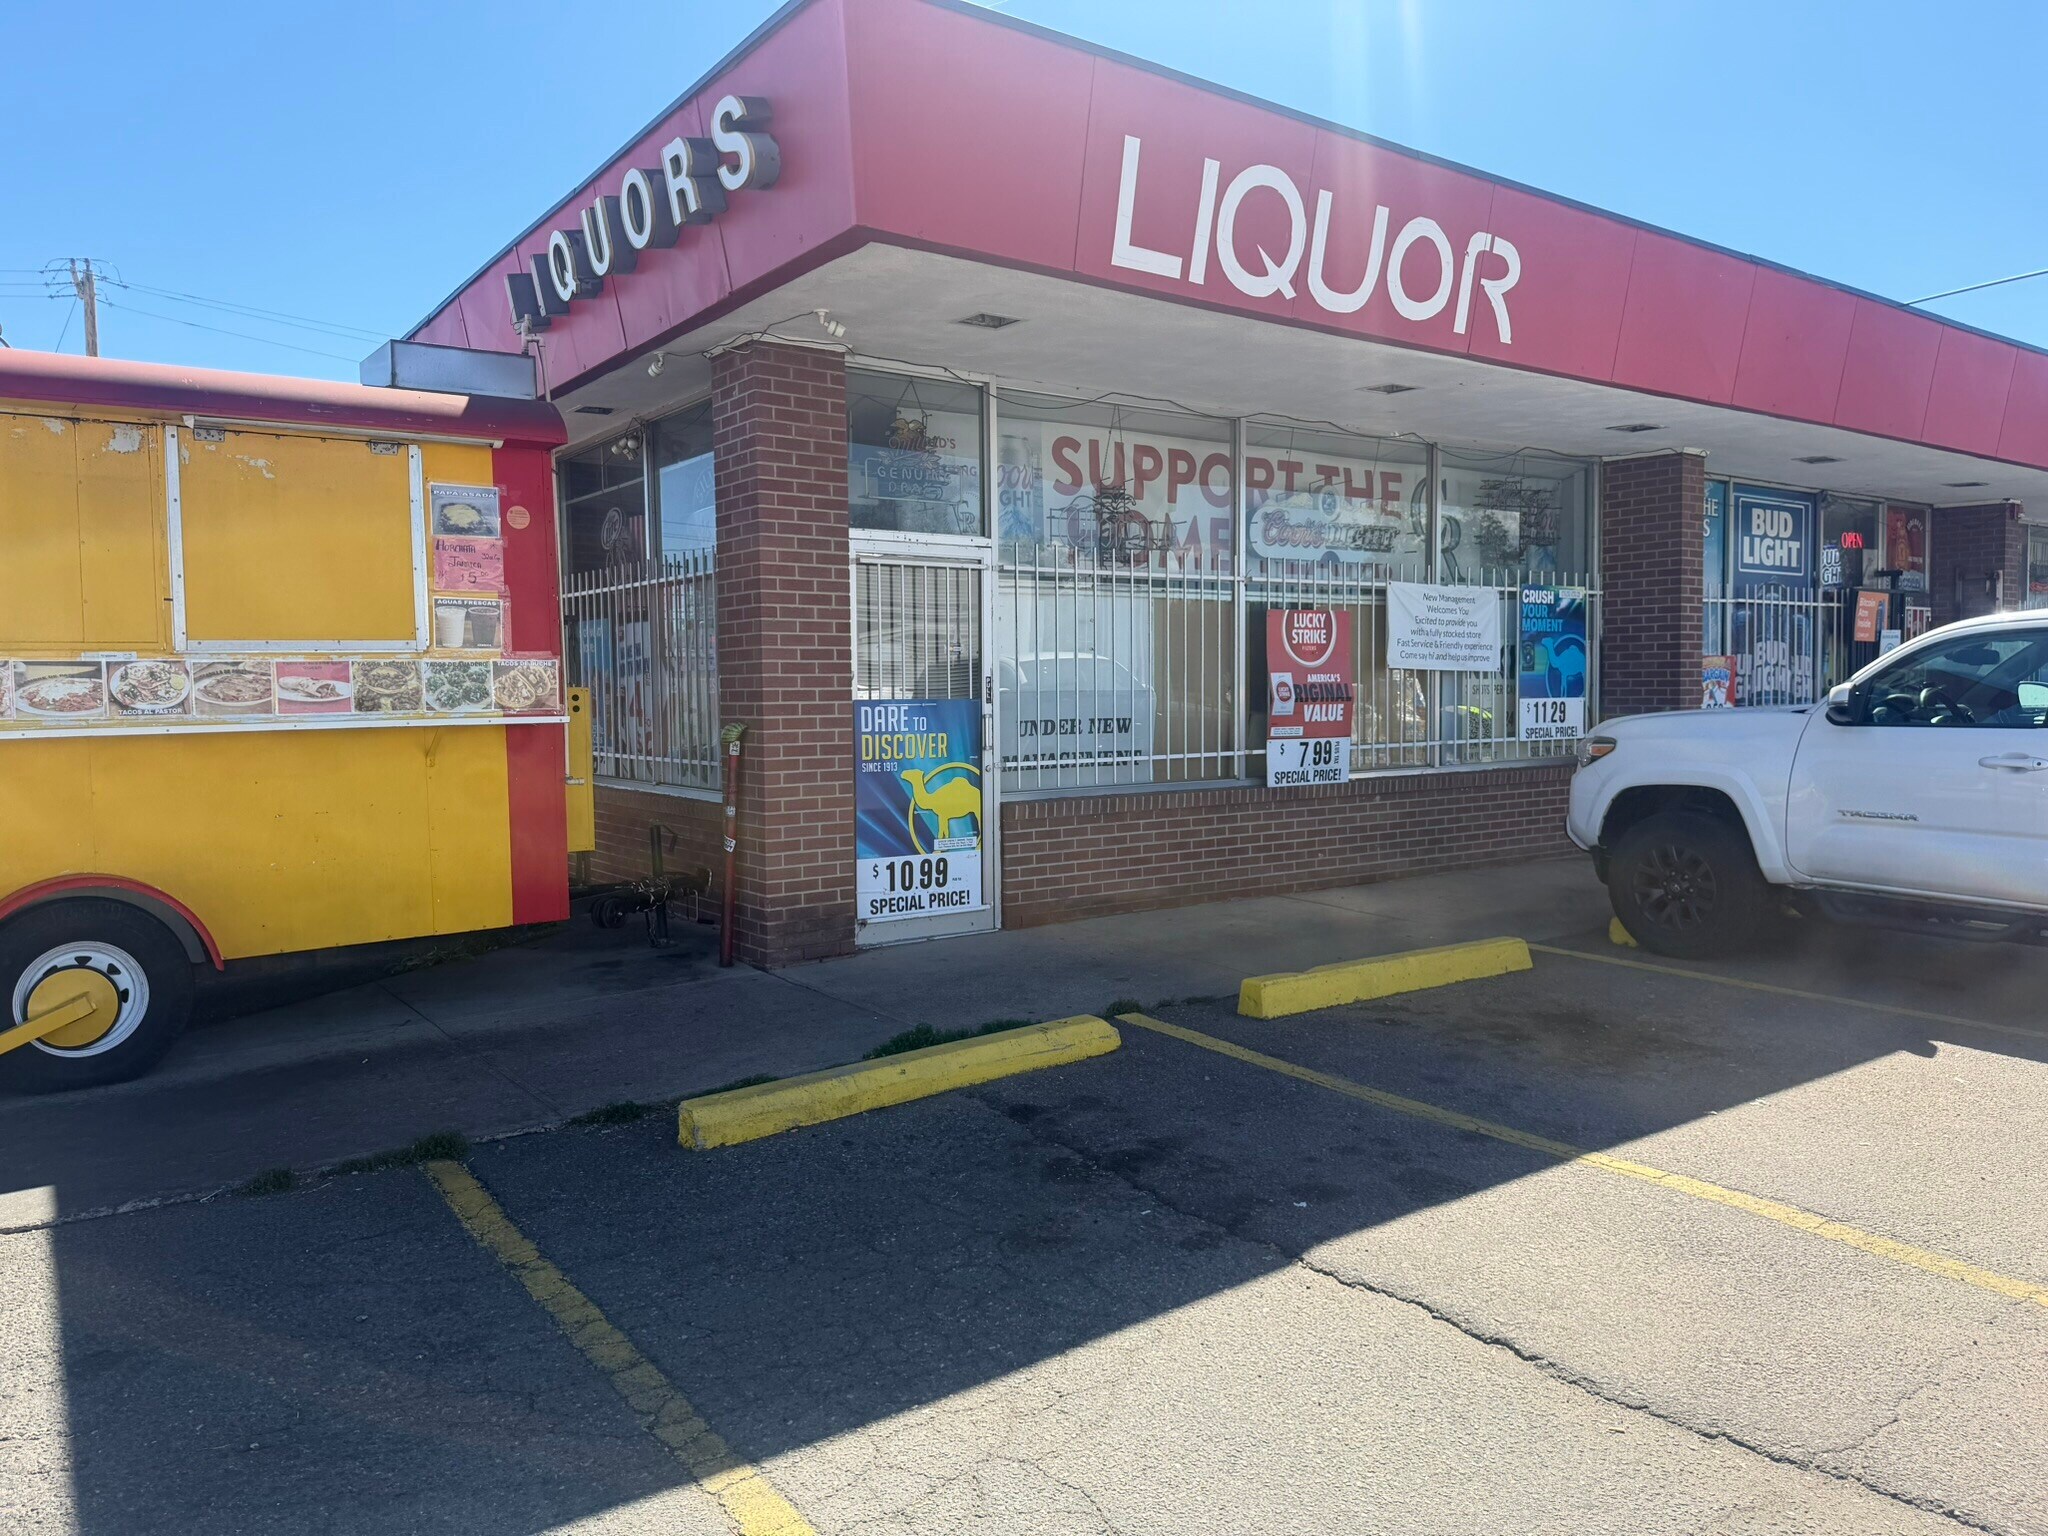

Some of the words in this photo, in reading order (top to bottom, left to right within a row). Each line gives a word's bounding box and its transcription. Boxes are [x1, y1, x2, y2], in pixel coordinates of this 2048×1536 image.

[1111, 134, 1521, 344] LIQUOR
[1052, 436, 1305, 508] SUPPORT
[998, 490, 1031, 508] GHT
[1751, 508, 1793, 538] BUD
[1841, 531, 1863, 549] OPEN
[1743, 536, 1801, 568] LIGHT
[1422, 592, 1438, 602] New
[1438, 593, 1476, 605] Management
[1522, 589, 1554, 604] CRUSH
[1426, 604, 1458, 615] Welcomes
[1458, 606, 1470, 616] You
[1522, 604, 1548, 618] YOUR
[1294, 613, 1326, 628] LUCKY
[1414, 615, 1437, 625] Excited
[1438, 617, 1445, 626] to
[1445, 617, 1466, 627] provide
[1466, 620, 1478, 629] you
[1522, 618, 1564, 632] MOMENT
[1292, 629, 1327, 644] STRIKE
[1410, 627, 1425, 636] with
[1429, 628, 1442, 638] fully
[1442, 629, 1465, 639] stocked
[1465, 631, 1482, 639] store
[1396, 638, 1410, 647] Fast
[1411, 638, 1433, 648] Service
[1434, 640, 1439, 648] &
[1440, 640, 1463, 651] Friendly
[1464, 642, 1493, 651] experience
[1400, 650, 1418, 659] Come
[1418, 652, 1428, 661] say
[1428, 651, 1435, 660] hi
[1435, 652, 1447, 661] and
[1448, 653, 1461, 662] help
[1467, 653, 1490, 662] improve
[1307, 673, 1341, 682] AMERICA'S
[860, 706, 909, 732] DARE
[913, 717, 927, 731] TO
[1304, 703, 1344, 722] VALUE
[1533, 701, 1566, 724] 11.29
[1016, 718, 1082, 738] UNDER
[1088, 717, 1132, 734] NEW
[1526, 727, 1552, 739] SPECIAL
[1554, 725, 1577, 738] PRICE!
[861, 733, 948, 760] DISCOVER
[1300, 740, 1333, 767] 7.99
[861, 763, 882, 772] SINCE
[883, 762, 898, 772] 1913
[1274, 769, 1311, 785] SPECIAL
[1312, 768, 1341, 783] PRICE!
[885, 857, 948, 892] 10.99
[870, 894, 925, 916] SPECIAL
[929, 890, 971, 909] PRICE!
